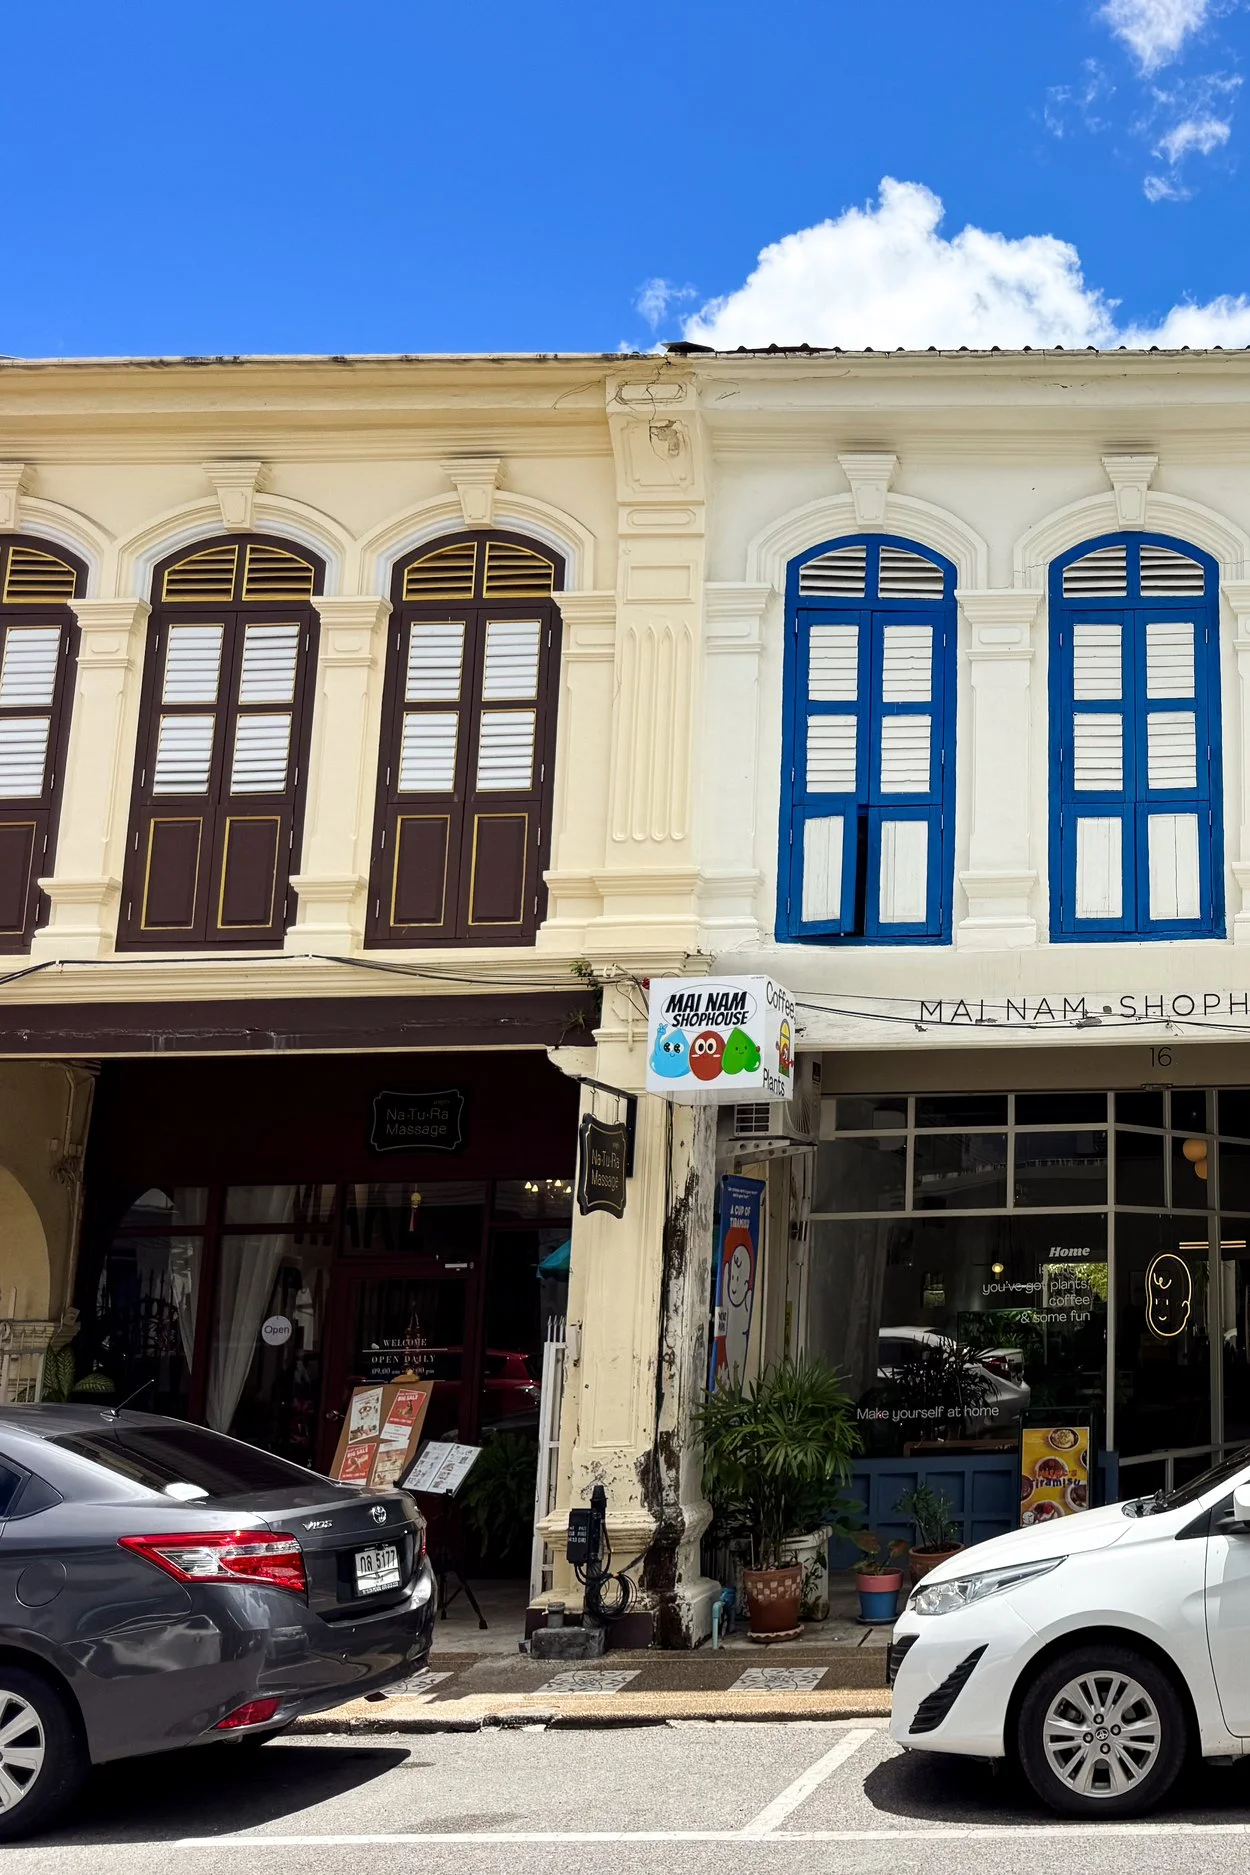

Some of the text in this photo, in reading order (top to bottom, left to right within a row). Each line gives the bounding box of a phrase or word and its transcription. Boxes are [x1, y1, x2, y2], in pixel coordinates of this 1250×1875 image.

[665, 991, 748, 1014] MAI NAM
[920, 999, 984, 1023] MAI
[1006, 997, 1087, 1021] NAM
[672, 1010, 750, 1028] SHOPHOUSE
[1149, 1046, 1172, 1067] 16
[763, 1068, 785, 1097] Plants
[386, 1123, 447, 1137] Massage
[591, 1169, 619, 1192] Massage
[1048, 1246, 1091, 1258] Home
[1048, 1294, 1091, 1306] coffee
[1020, 1310, 1091, 1324] & some fun
[264, 1325, 290, 1336] Open
[383, 1338, 427, 1347] WELCOME
[371, 1354, 436, 1363] OPEN DAILY
[856, 1405, 1000, 1422] Make yourself at home
[1031, 1478, 1081, 1489] iramisu
[302, 1519, 333, 1532] VIOS
[375, 1549, 395, 1569] 5177
